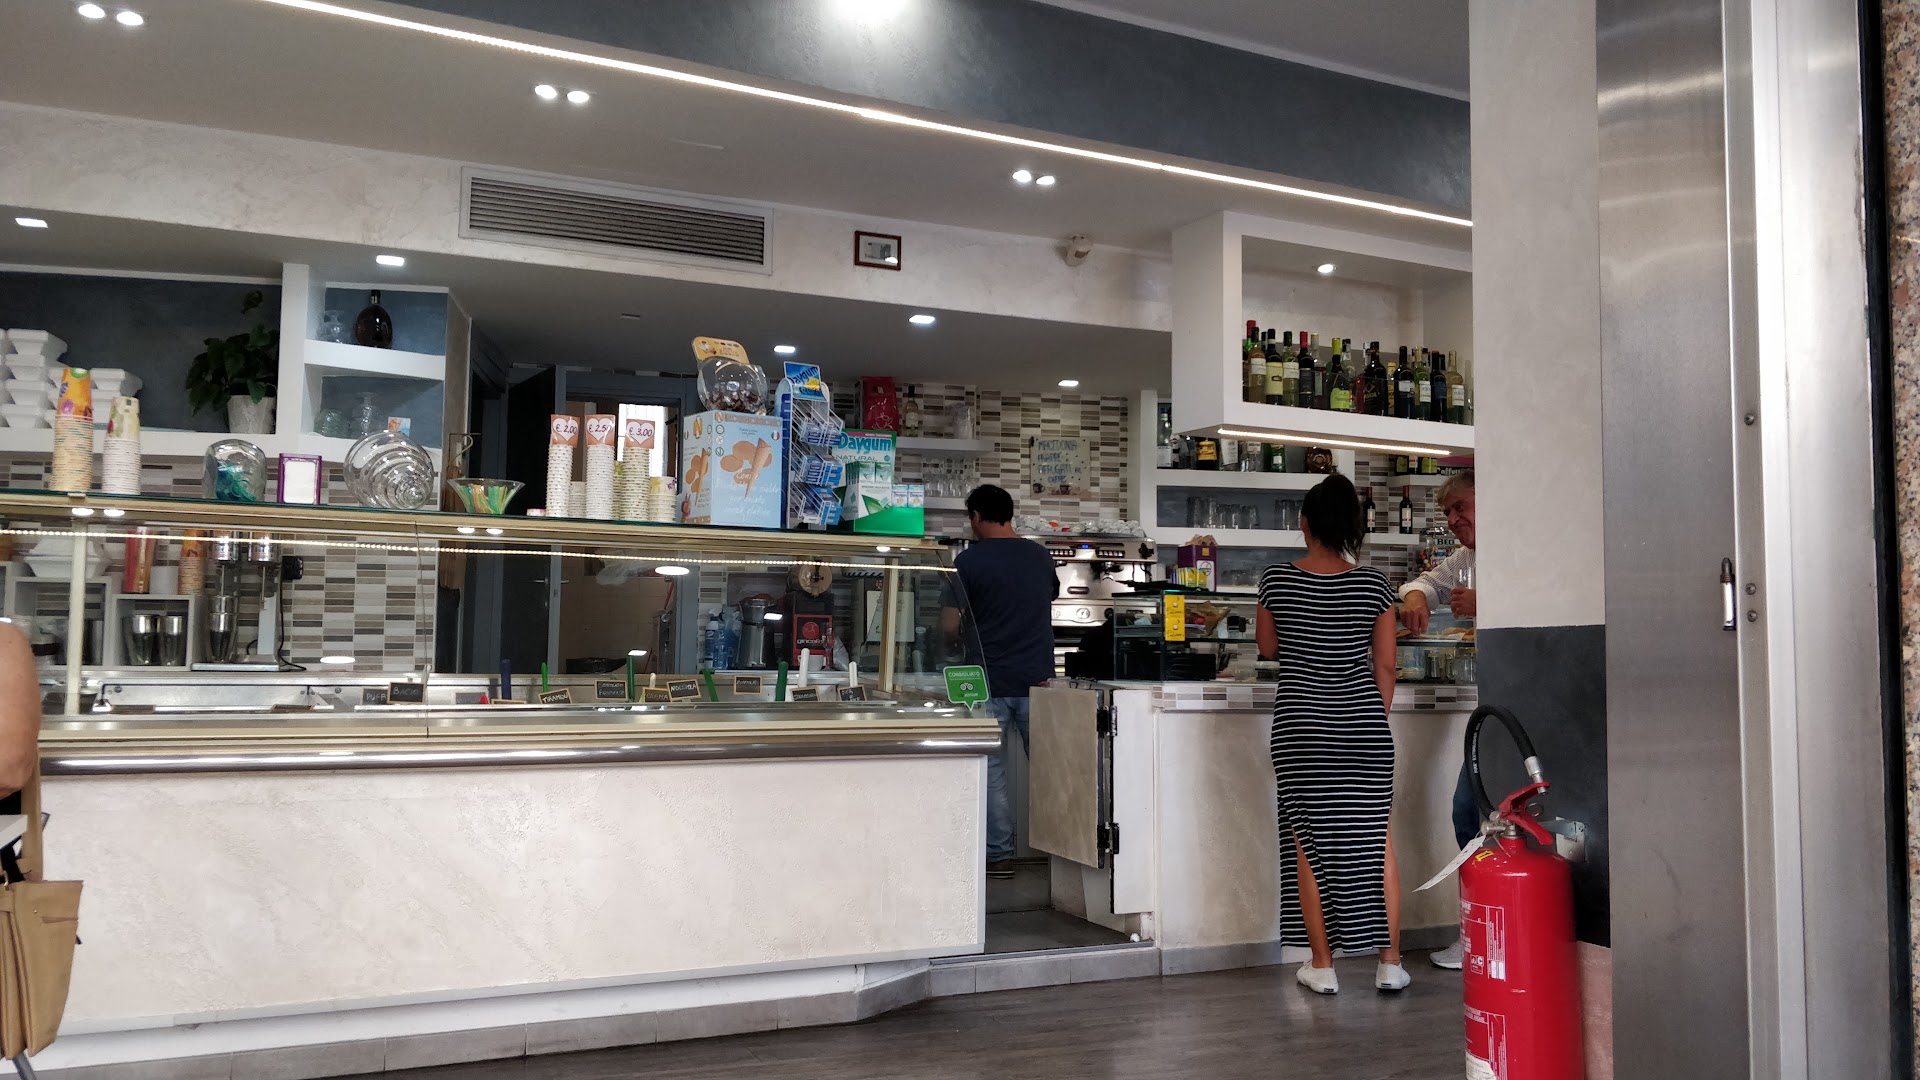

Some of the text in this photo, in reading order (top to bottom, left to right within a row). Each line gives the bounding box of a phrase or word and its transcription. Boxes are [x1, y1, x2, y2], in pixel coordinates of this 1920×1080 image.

[837, 431, 892, 455] Daygum
[835, 454, 878, 462] NATURAL
[393, 686, 419, 696] BACIO
